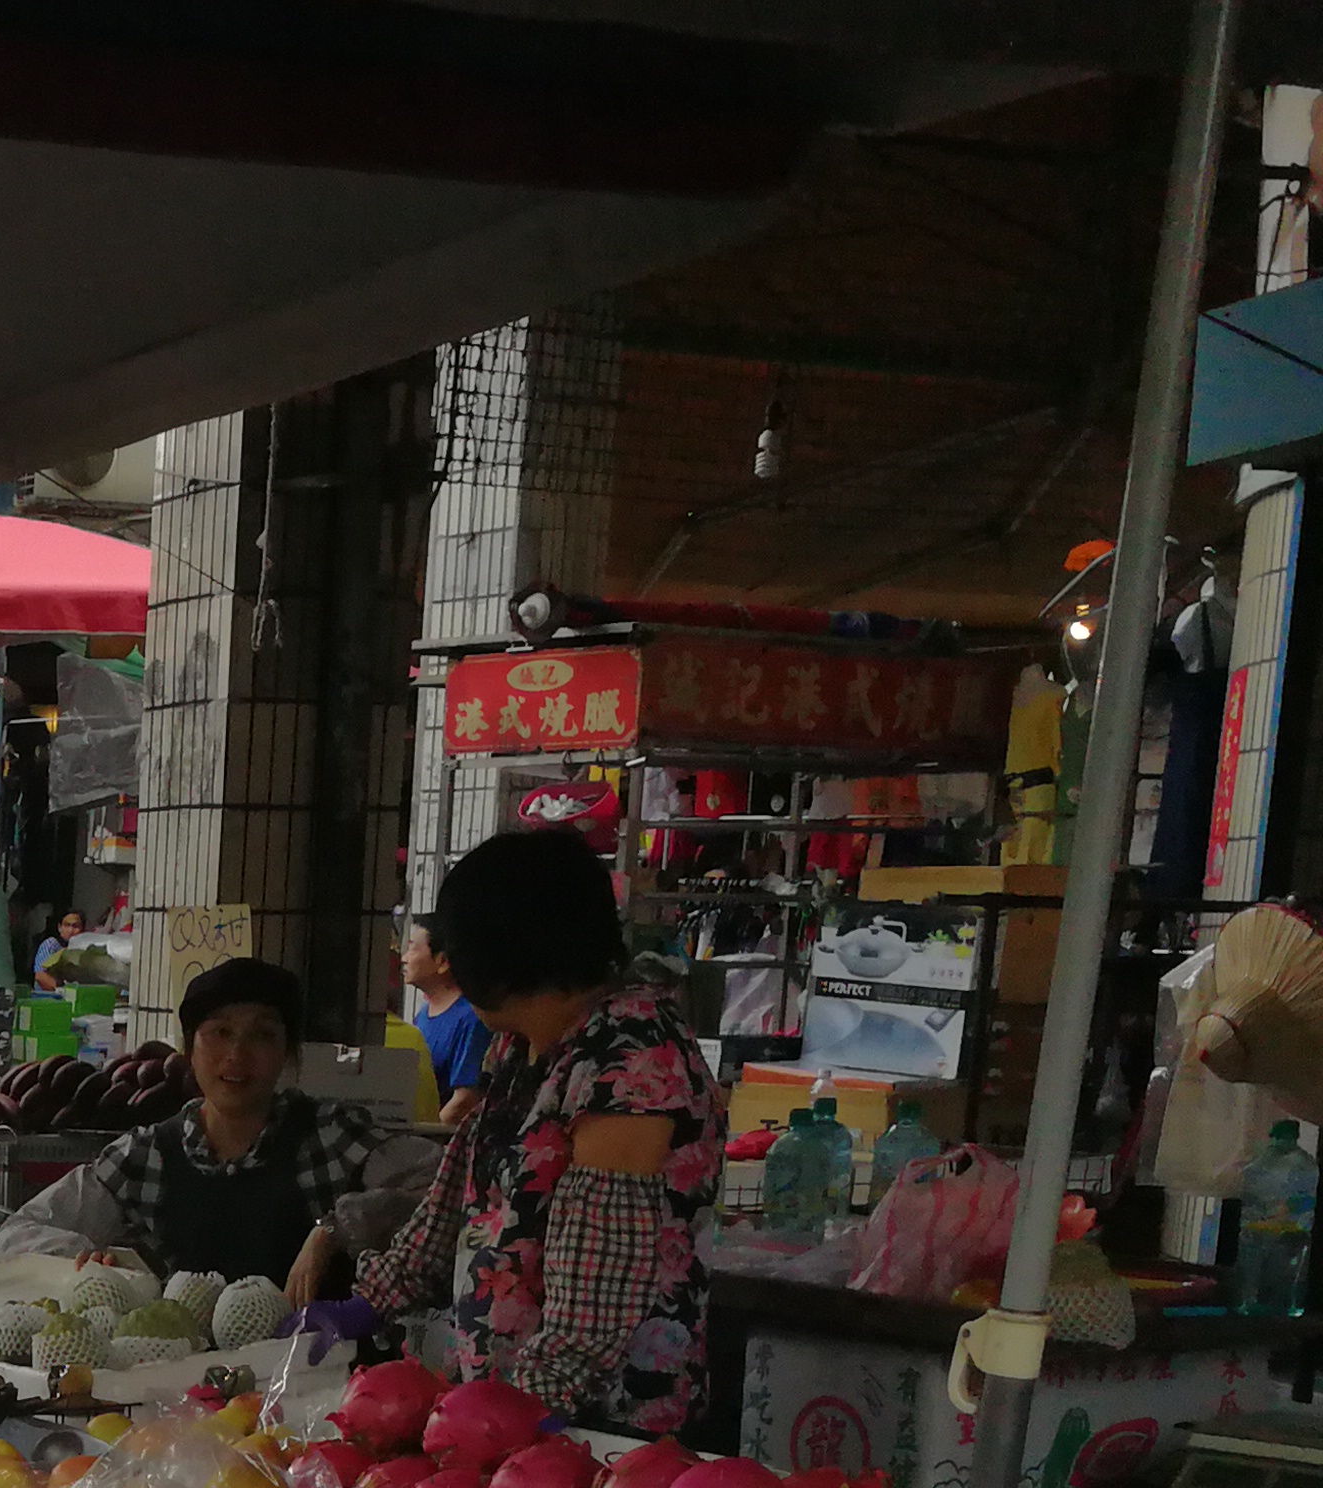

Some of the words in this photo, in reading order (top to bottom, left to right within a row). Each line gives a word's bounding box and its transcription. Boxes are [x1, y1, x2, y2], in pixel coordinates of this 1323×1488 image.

[454, 688, 626, 741] 港式燒臘
[828, 982, 872, 996] PERFECT
